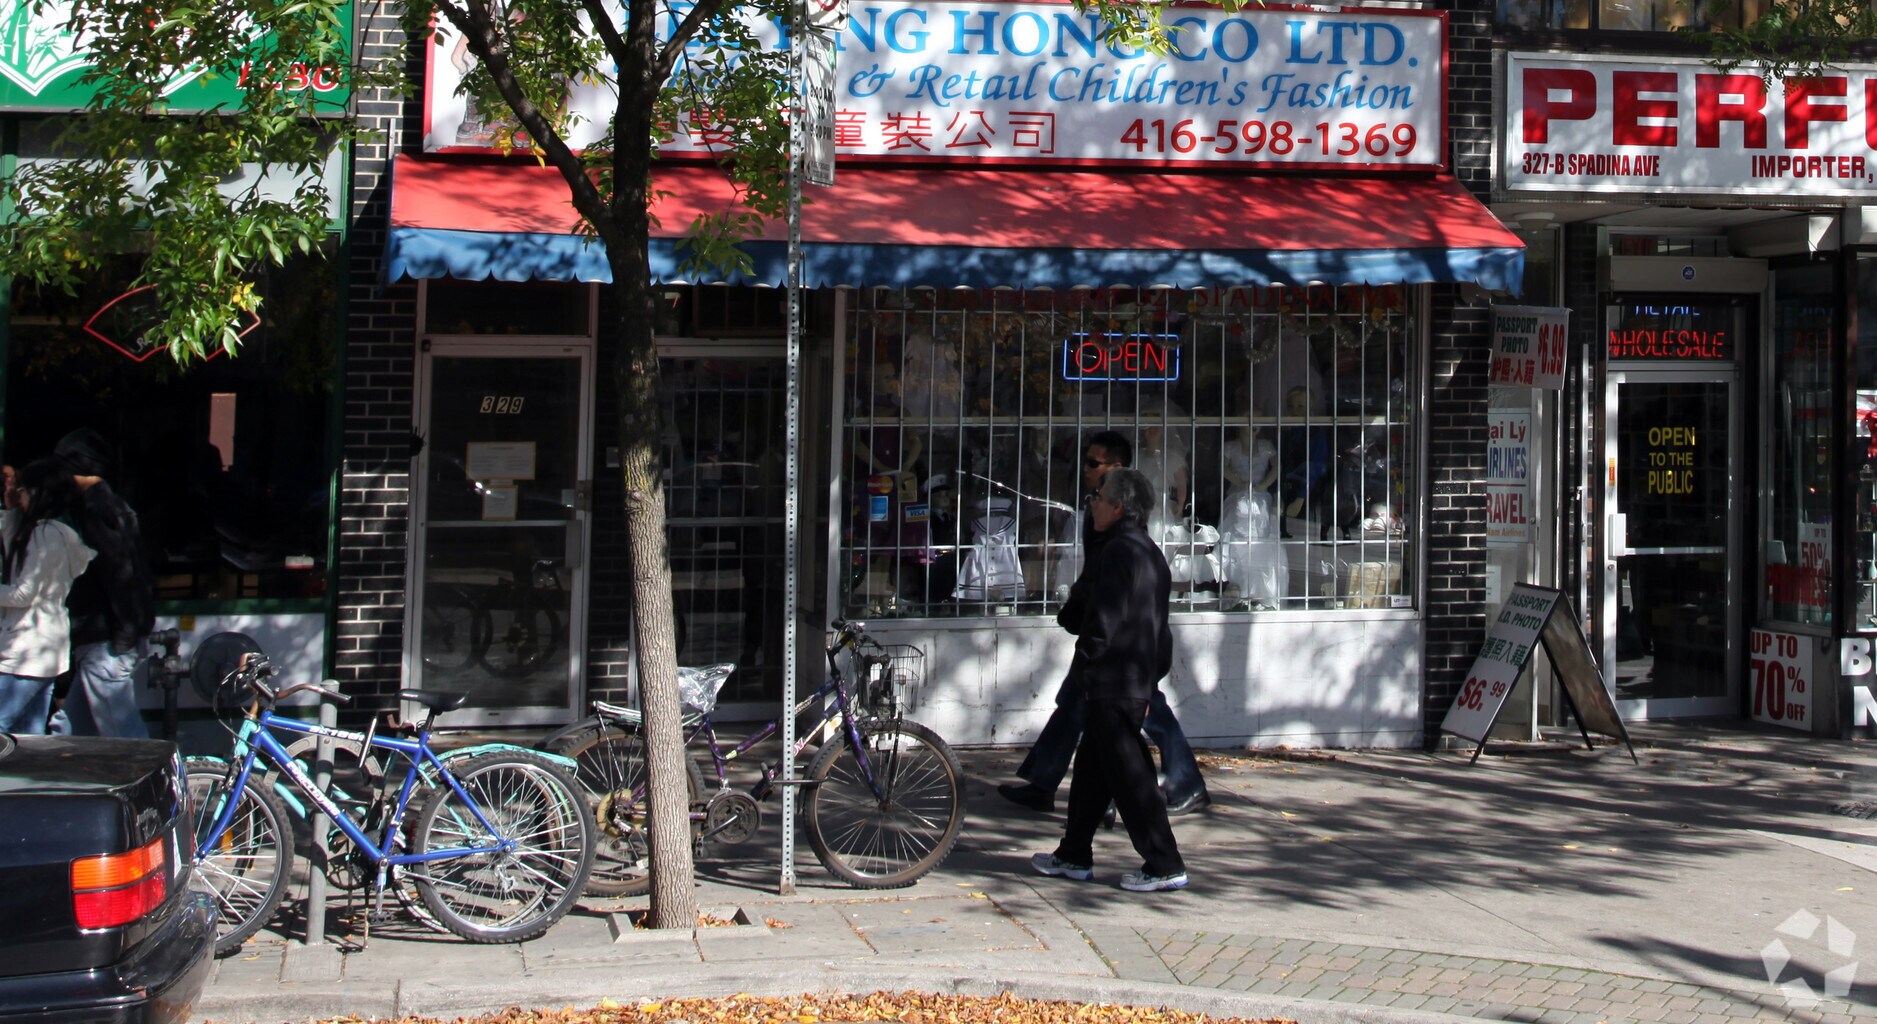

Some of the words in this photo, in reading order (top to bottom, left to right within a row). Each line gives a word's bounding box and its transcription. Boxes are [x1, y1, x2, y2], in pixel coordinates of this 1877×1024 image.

[1166, 16, 1259, 64] CO
[1285, 20, 1418, 68] LTD.
[848, 63, 896, 99] &
[905, 61, 1047, 108] Retail
[1049, 61, 1249, 107] Children's
[1256, 70, 1414, 113] Fashion
[1522, 67, 1877, 151] PERF
[1119, 119, 1417, 157] 416-598-1369
[1522, 152, 1565, 176] 327-B
[1568, 153, 1630, 177] SPADINA
[1634, 155, 1660, 177] AVE
[1752, 155, 1874, 183] IMPORTER,
[1496, 317, 1538, 334] PASSPORT
[1075, 341, 1166, 373] OPEN
[1501, 336, 1529, 354] PHOTO
[1538, 323, 1565, 376] $6.99
[482, 396, 523, 414] 329
[1487, 420, 1504, 444] ại
[1509, 419, 1526, 443] Lý
[1648, 427, 1695, 446] OPEN
[1487, 446, 1527, 479] IRLINES
[1649, 452, 1666, 466] TO
[1669, 452, 1693, 466] THE
[1648, 470, 1693, 494] PUBLIC
[1486, 492, 1526, 524] RAVEL
[1508, 592, 1551, 612] PASSPORT
[1512, 613, 1542, 631] PHOTO
[1751, 631, 1772, 655] UP
[1776, 634, 1798, 659] TO
[1787, 702, 1805, 722] OFF
